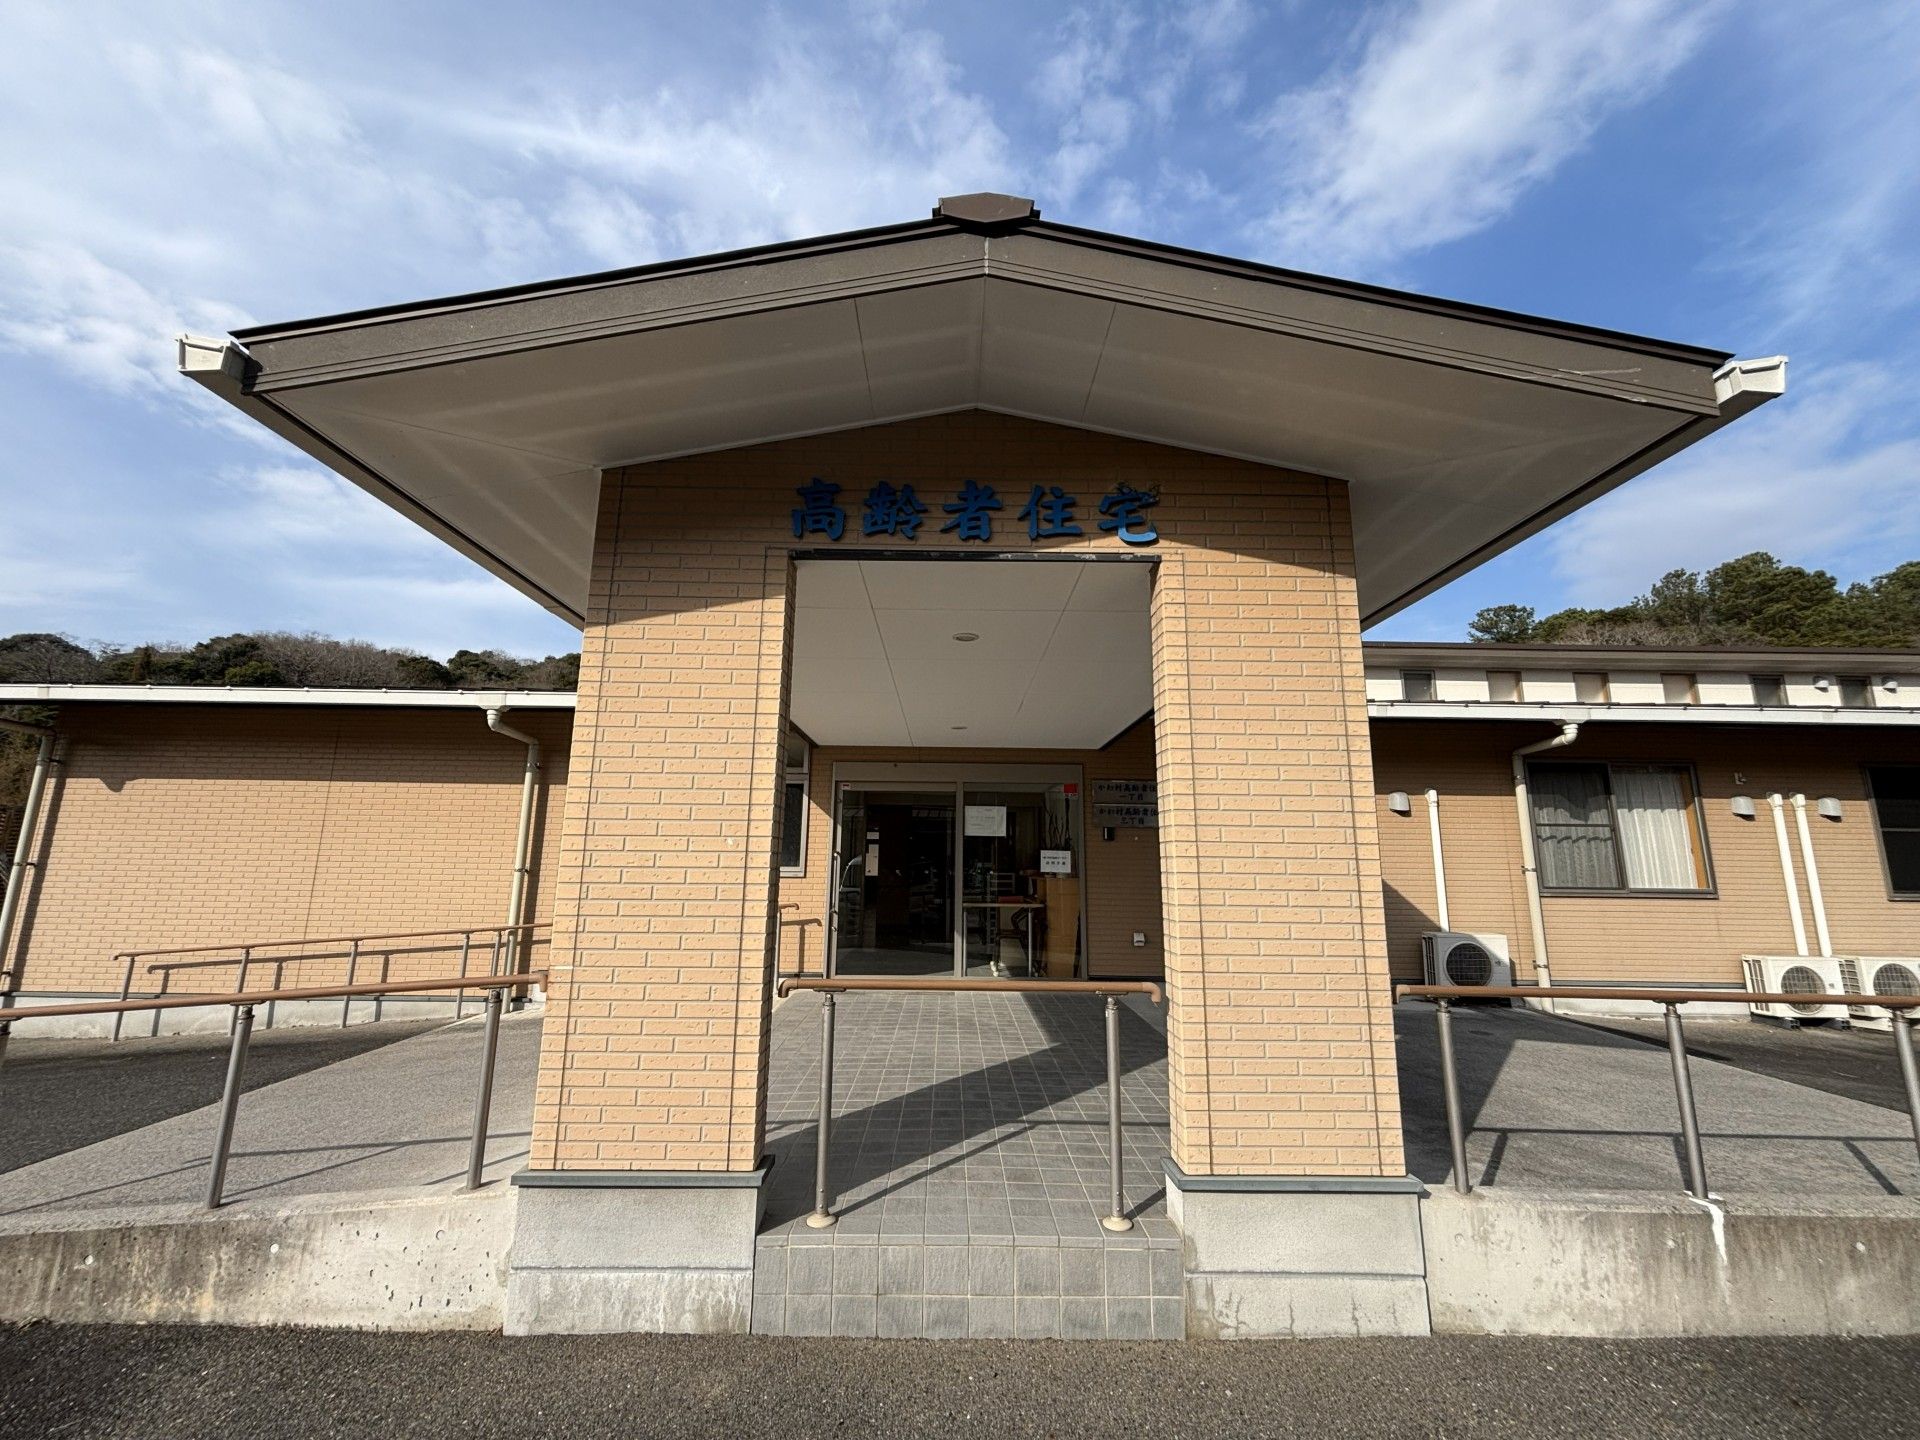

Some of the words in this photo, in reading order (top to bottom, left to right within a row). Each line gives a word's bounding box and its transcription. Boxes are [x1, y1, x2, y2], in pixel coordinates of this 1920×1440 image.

[791, 477, 1160, 544] 高齢者住宅
